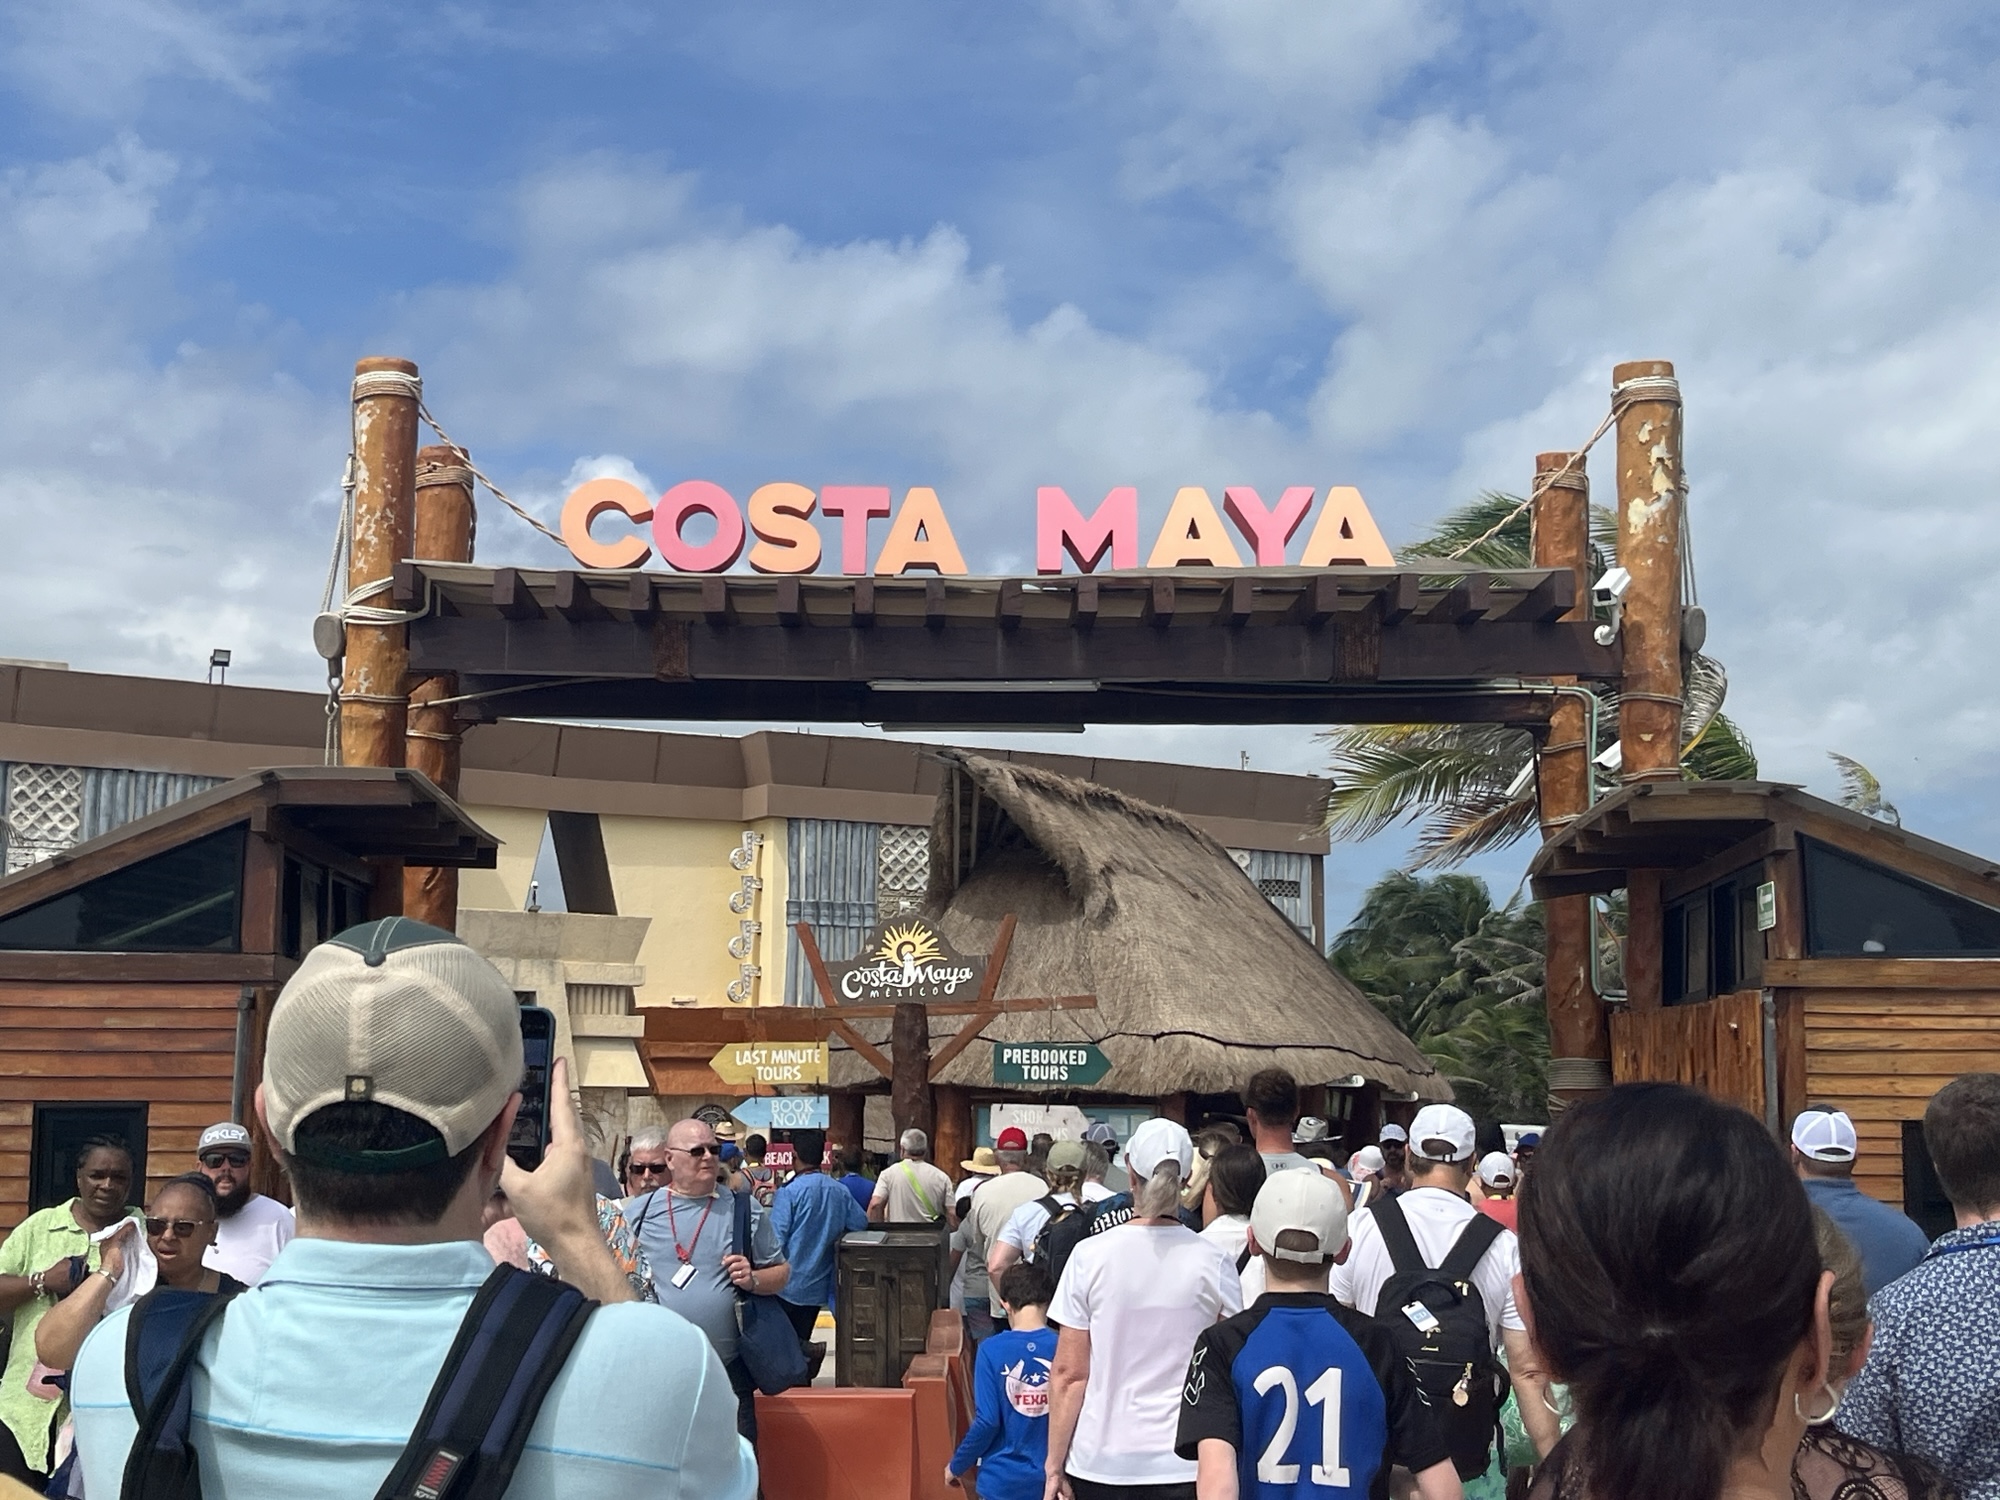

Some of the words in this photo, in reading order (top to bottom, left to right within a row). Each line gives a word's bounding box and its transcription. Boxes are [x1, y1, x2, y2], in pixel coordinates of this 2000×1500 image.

[560, 478, 968, 575] COSTA
[1037, 486, 1397, 575] MAYA
[841, 960, 902, 999] Costa
[912, 964, 973, 995] Maya
[735, 1049, 768, 1066] LAST
[770, 1048, 821, 1065] MINUTE
[1003, 1048, 1087, 1066] PREBOOKED
[755, 1065, 802, 1081] TOURS
[1022, 1065, 1069, 1081] TOURS
[771, 1099, 815, 1114] BOOK
[772, 1112, 812, 1127] NOW
[1014, 1394, 1049, 1406] TEXA
[1253, 1365, 1350, 1487] 21
